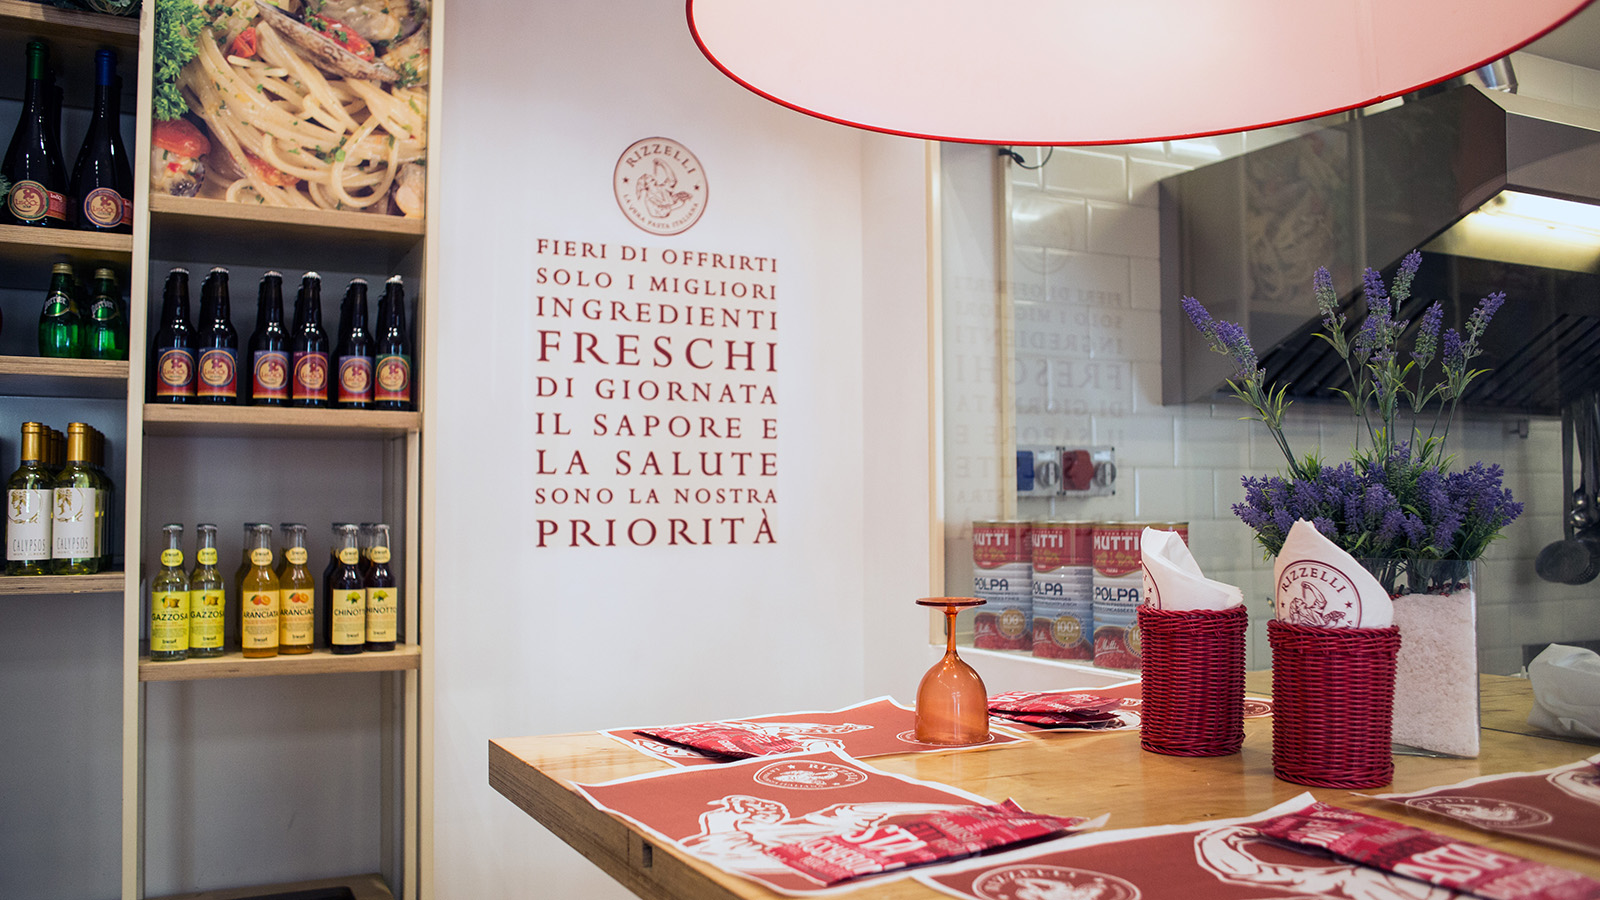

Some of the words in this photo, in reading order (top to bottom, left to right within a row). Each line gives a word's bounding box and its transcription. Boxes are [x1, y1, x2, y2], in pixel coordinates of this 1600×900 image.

[626, 144, 696, 174] RIZZELLI
[537, 238, 607, 259] FIERI
[621, 245, 647, 262] DI
[662, 249, 777, 273] OFFRIRTI
[537, 267, 612, 288] SOLO
[628, 274, 635, 290] I
[649, 276, 776, 300] MIGLIORI
[536, 295, 777, 330] INGREDIENTI
[537, 330, 777, 372] FRESCHI
[536, 376, 574, 398] DI
[595, 378, 777, 404] GIORNATA
[535, 412, 571, 435] IL
[593, 413, 742, 438] SAPORE
[762, 418, 778, 440] E
[536, 449, 589, 475] LA
[615, 450, 778, 476] SALUTE
[535, 487, 614, 504] SONO
[629, 488, 660, 504] LA
[674, 488, 778, 504] NOSTRA
[536, 508, 777, 547] PRIORITÀ
[13, 538, 46, 552] CALYPSOS
[57, 537, 89, 550] CALYPSOS
[1094, 536, 1139, 551] MUTTI
[1095, 587, 1139, 602] POLPA
[1281, 568, 1347, 594] RIZZELLI
